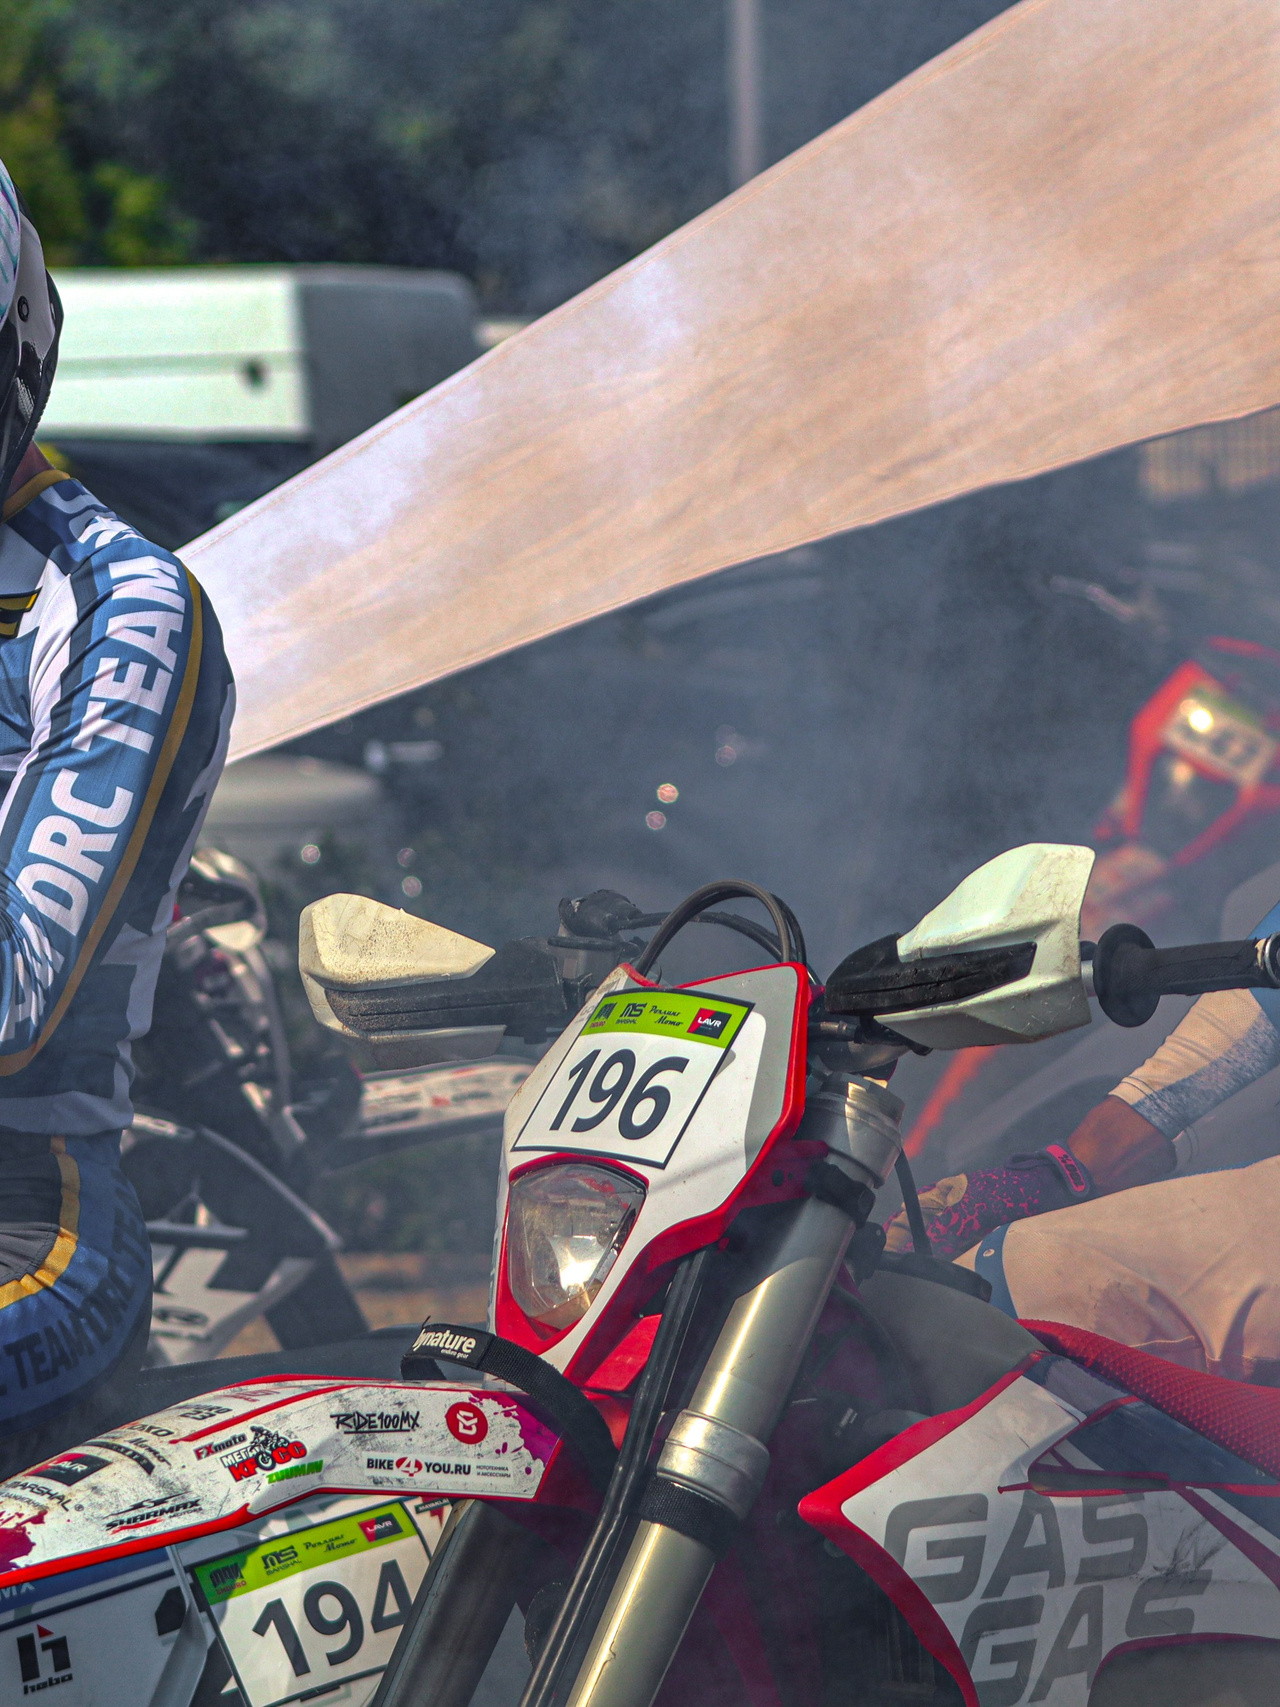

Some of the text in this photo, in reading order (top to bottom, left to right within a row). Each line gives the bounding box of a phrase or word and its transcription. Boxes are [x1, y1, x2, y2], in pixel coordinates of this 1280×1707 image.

[71, 554, 187, 754] TEAM
[16, 768, 135, 937] DRC
[697, 1016, 722, 1028] LAVR
[549, 1048, 691, 1141] 196
[47, 1460, 90, 1473] LAVR
[104, 1498, 202, 1532] SHARMAX
[366, 1519, 394, 1533] LAVR
[265, 1560, 302, 1577] MARSHAL
[883, 1492, 1149, 1606] GAS
[252, 1558, 414, 1678] 194
[958, 1568, 1214, 1707] GAS
[23, 1673, 74, 1695] hebo
